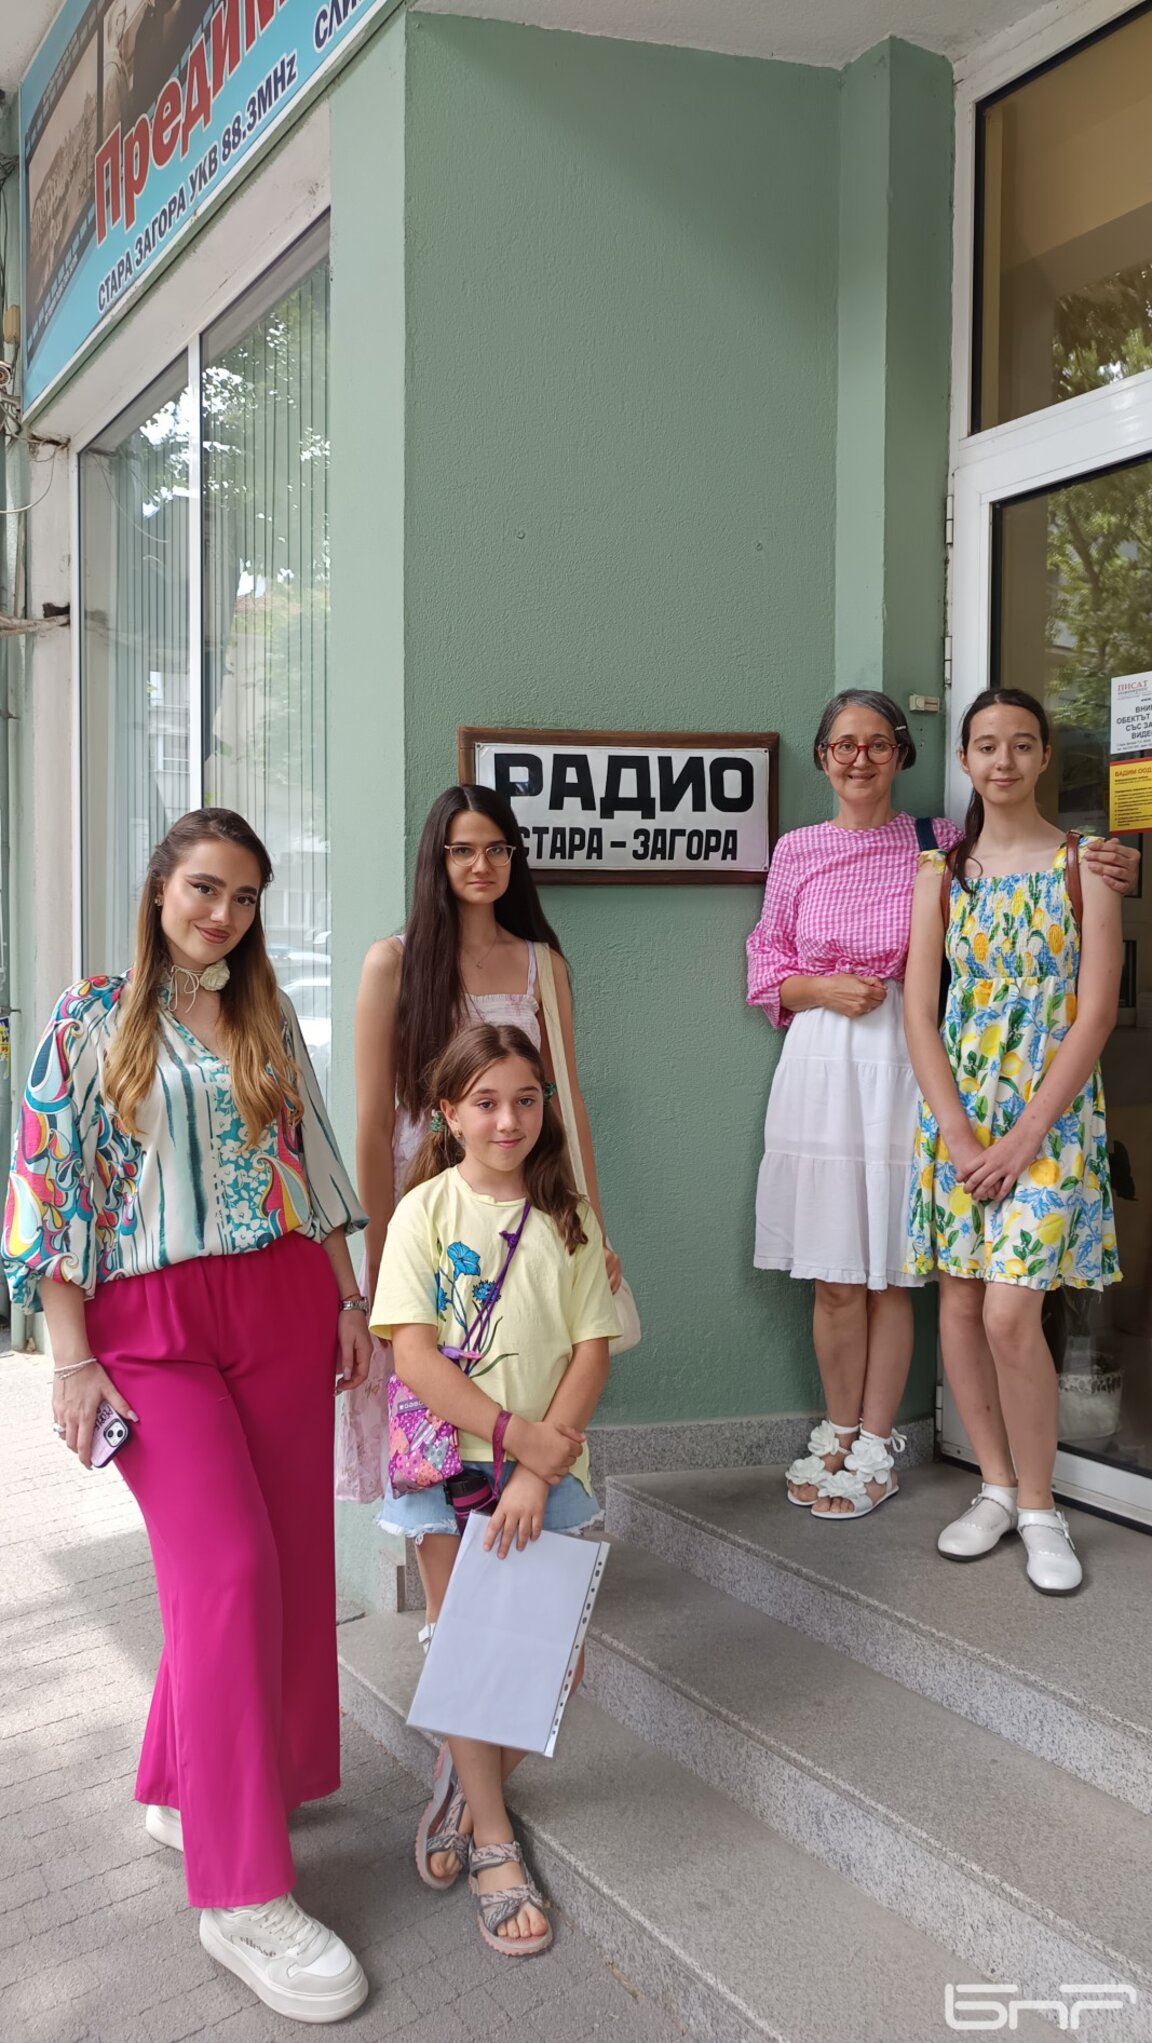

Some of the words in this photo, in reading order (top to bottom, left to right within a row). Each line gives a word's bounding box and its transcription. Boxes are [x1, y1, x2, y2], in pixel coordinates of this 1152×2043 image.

[98, 253, 133, 311] СТАРА
[135, 186, 186, 266] ЗАГОРА
[189, 145, 218, 201] УКВ
[222, 54, 297, 161] 88.3MHz
[1136, 704, 1152, 713] ВНИ
[1116, 712, 1150, 724] ОБЕКТЪТ
[1126, 722, 1141, 731] СЪС
[1131, 730, 1152, 739] ВИДЕ
[494, 753, 754, 819] РАДИО
[518, 827, 603, 860] СТАРА
[632, 828, 738, 861] ЗАГОРА
